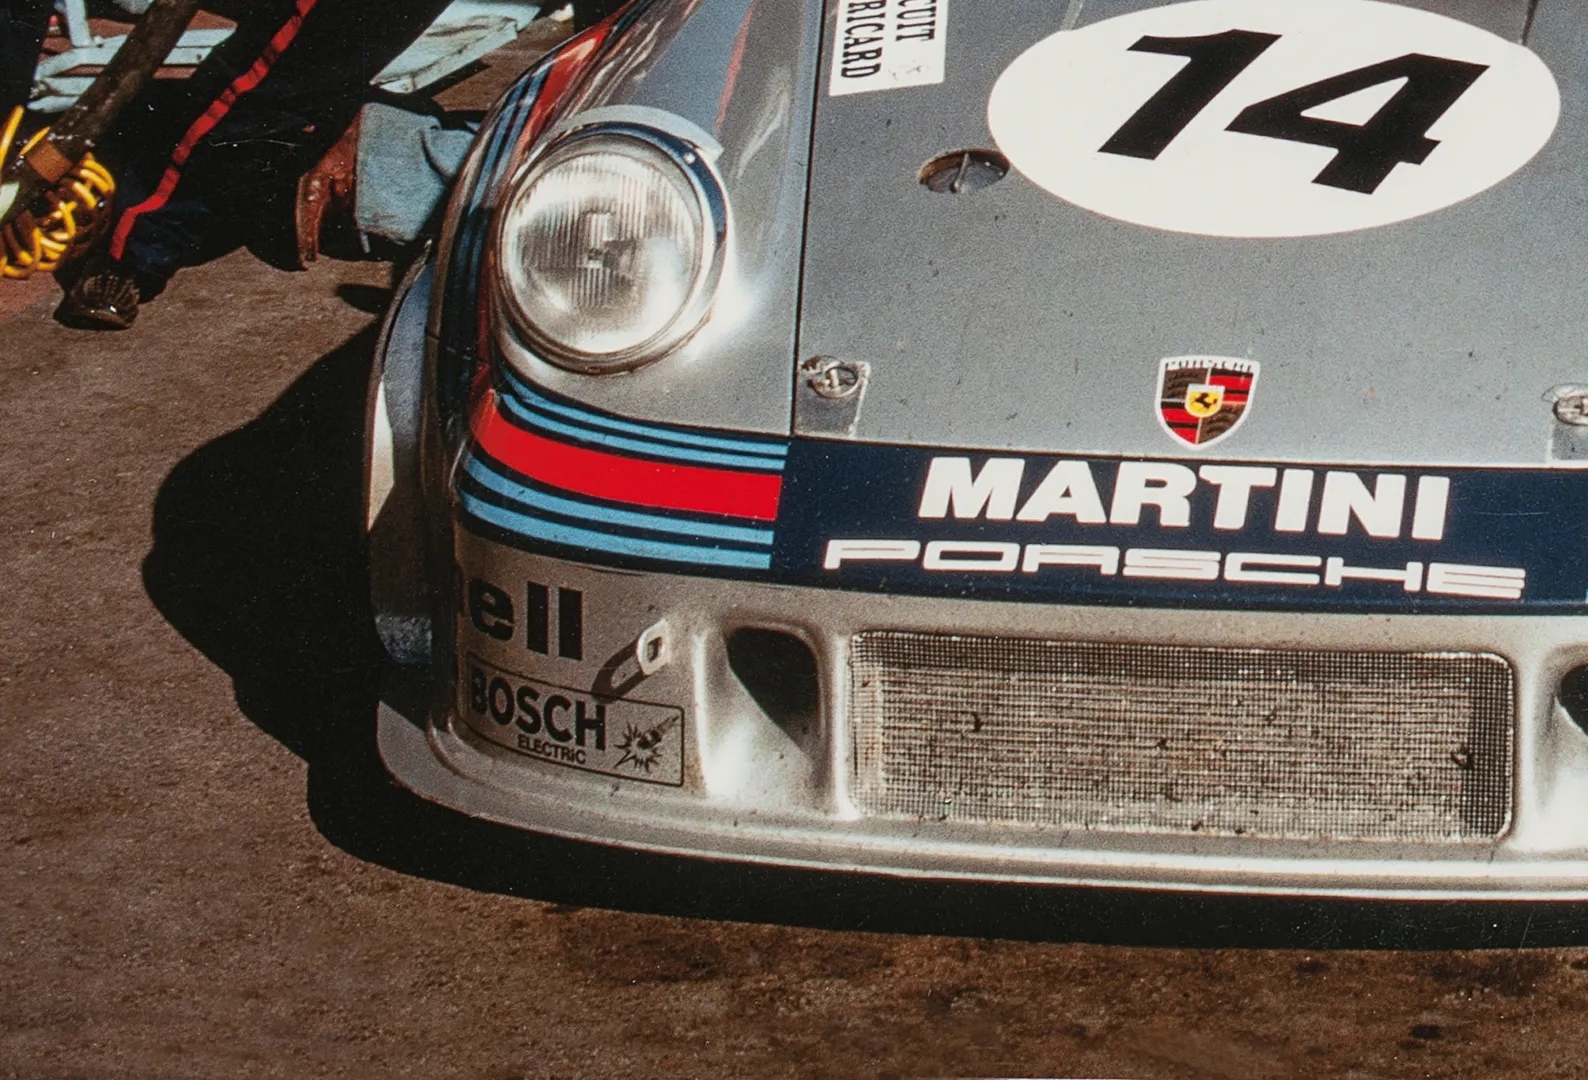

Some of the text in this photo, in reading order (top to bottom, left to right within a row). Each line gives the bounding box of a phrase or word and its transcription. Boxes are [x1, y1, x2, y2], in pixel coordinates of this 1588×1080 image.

[1097, 28, 1490, 195] 14
[918, 456, 1451, 541] MARTINI
[823, 539, 1527, 600] PORSCHE
[469, 578, 584, 661] ell
[470, 666, 607, 752] BOSCH
